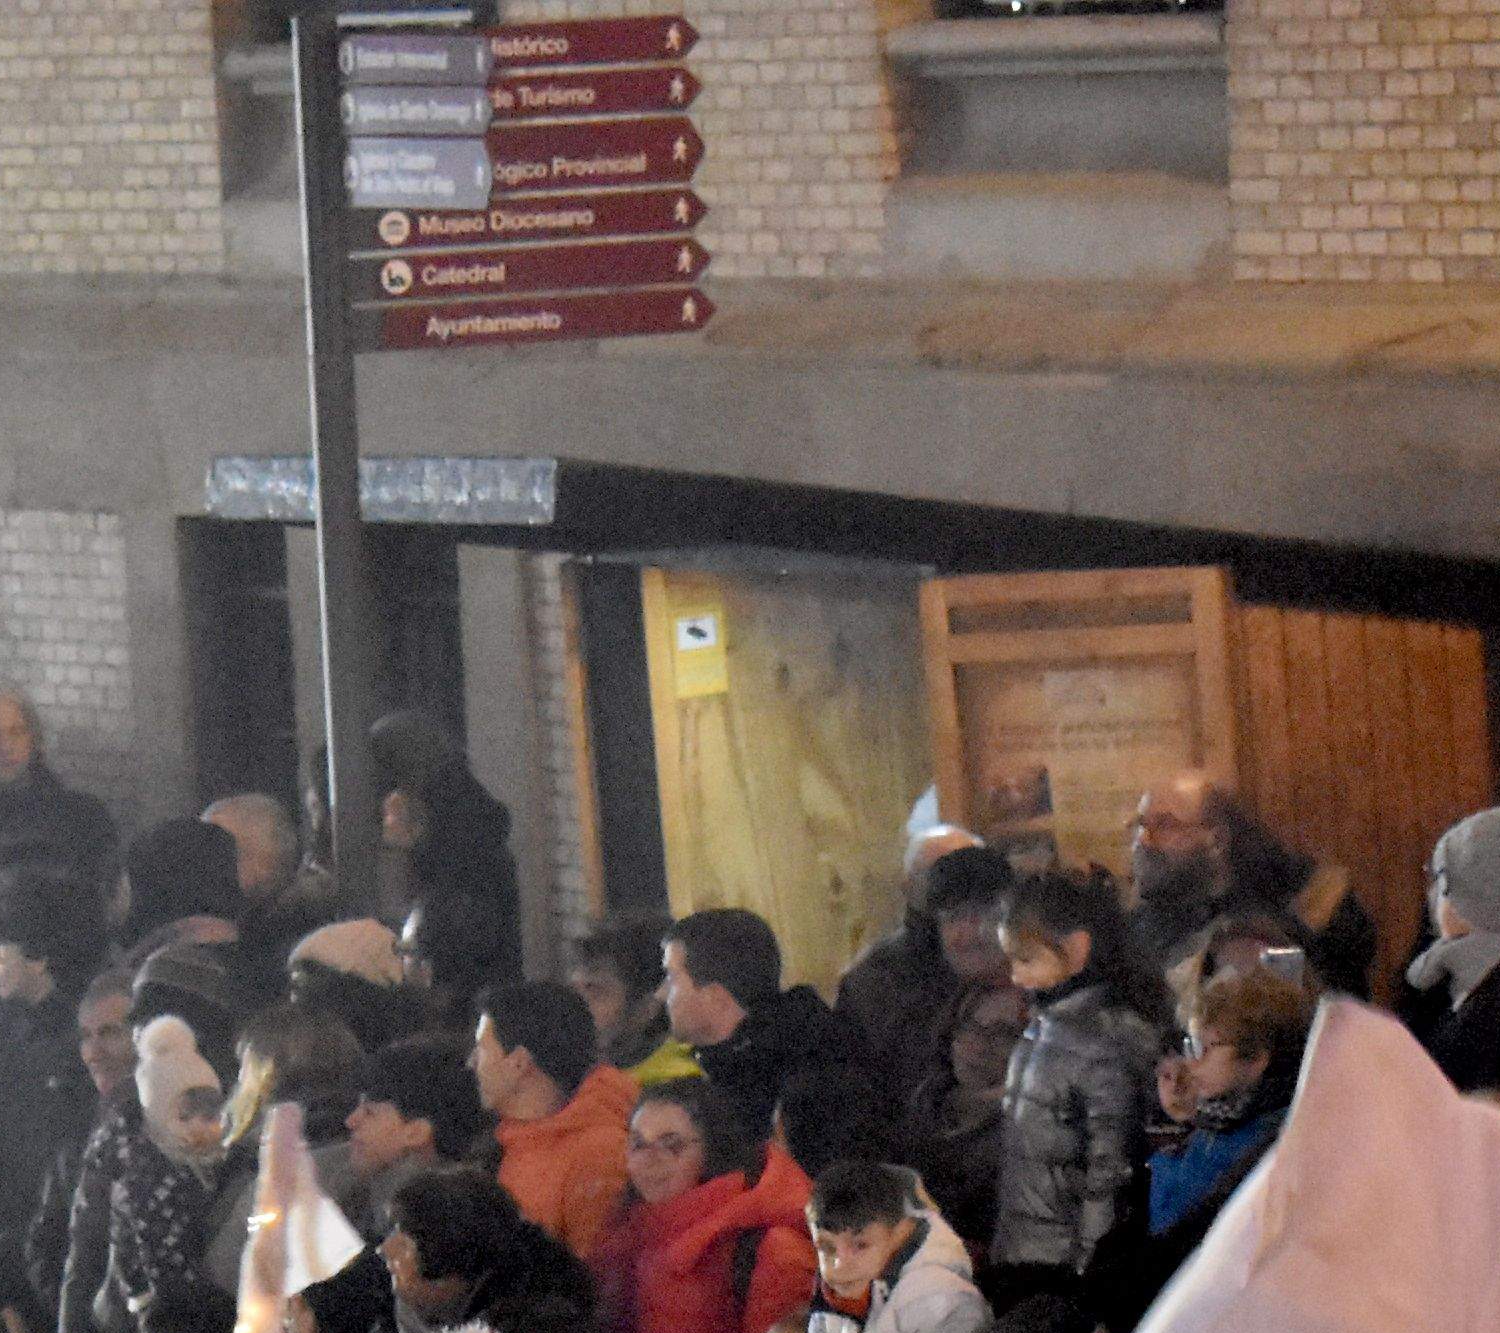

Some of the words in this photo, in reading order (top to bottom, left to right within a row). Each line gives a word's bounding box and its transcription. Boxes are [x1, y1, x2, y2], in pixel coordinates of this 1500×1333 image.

[518, 85, 596, 107] Turismo
[553, 152, 647, 178] Provincial
[418, 214, 486, 236] Museo
[490, 208, 595, 232] Diocesano
[422, 261, 506, 286] Catedral
[425, 311, 563, 342] Ayuntamiento
